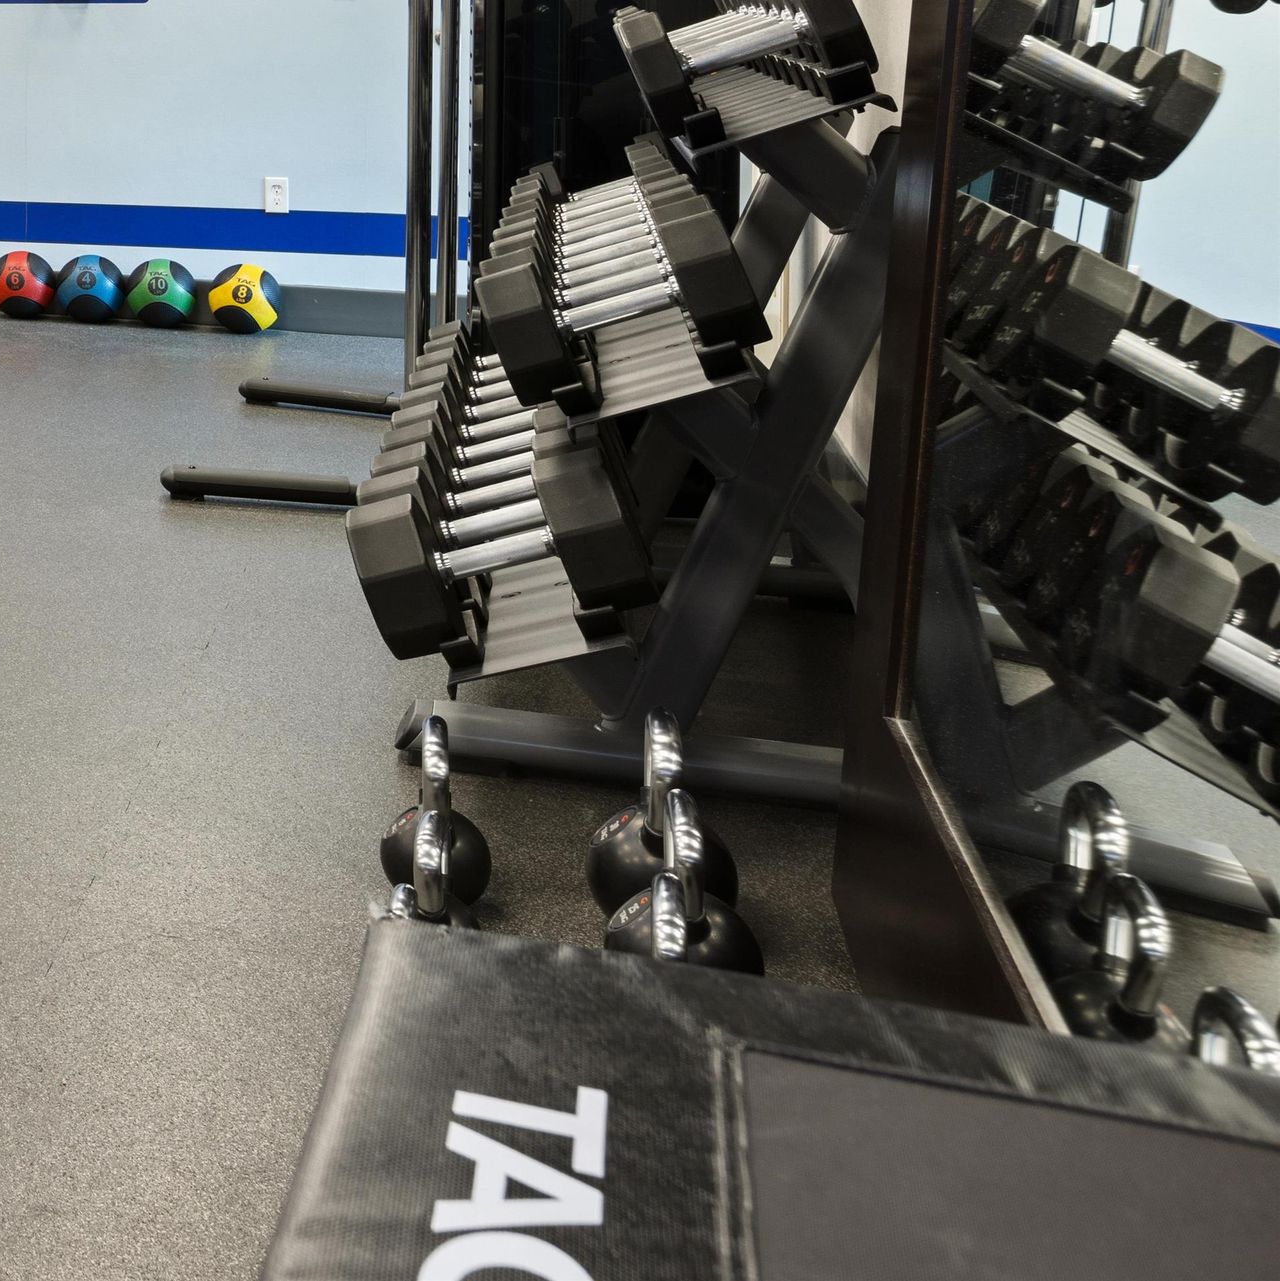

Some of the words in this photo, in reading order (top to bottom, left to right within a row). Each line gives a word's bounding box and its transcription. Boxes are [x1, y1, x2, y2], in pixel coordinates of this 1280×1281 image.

[11, 273, 20, 285] 6
[81, 273, 91, 284] 4
[150, 279, 166, 290] 10
[237, 286, 248, 298] 8
